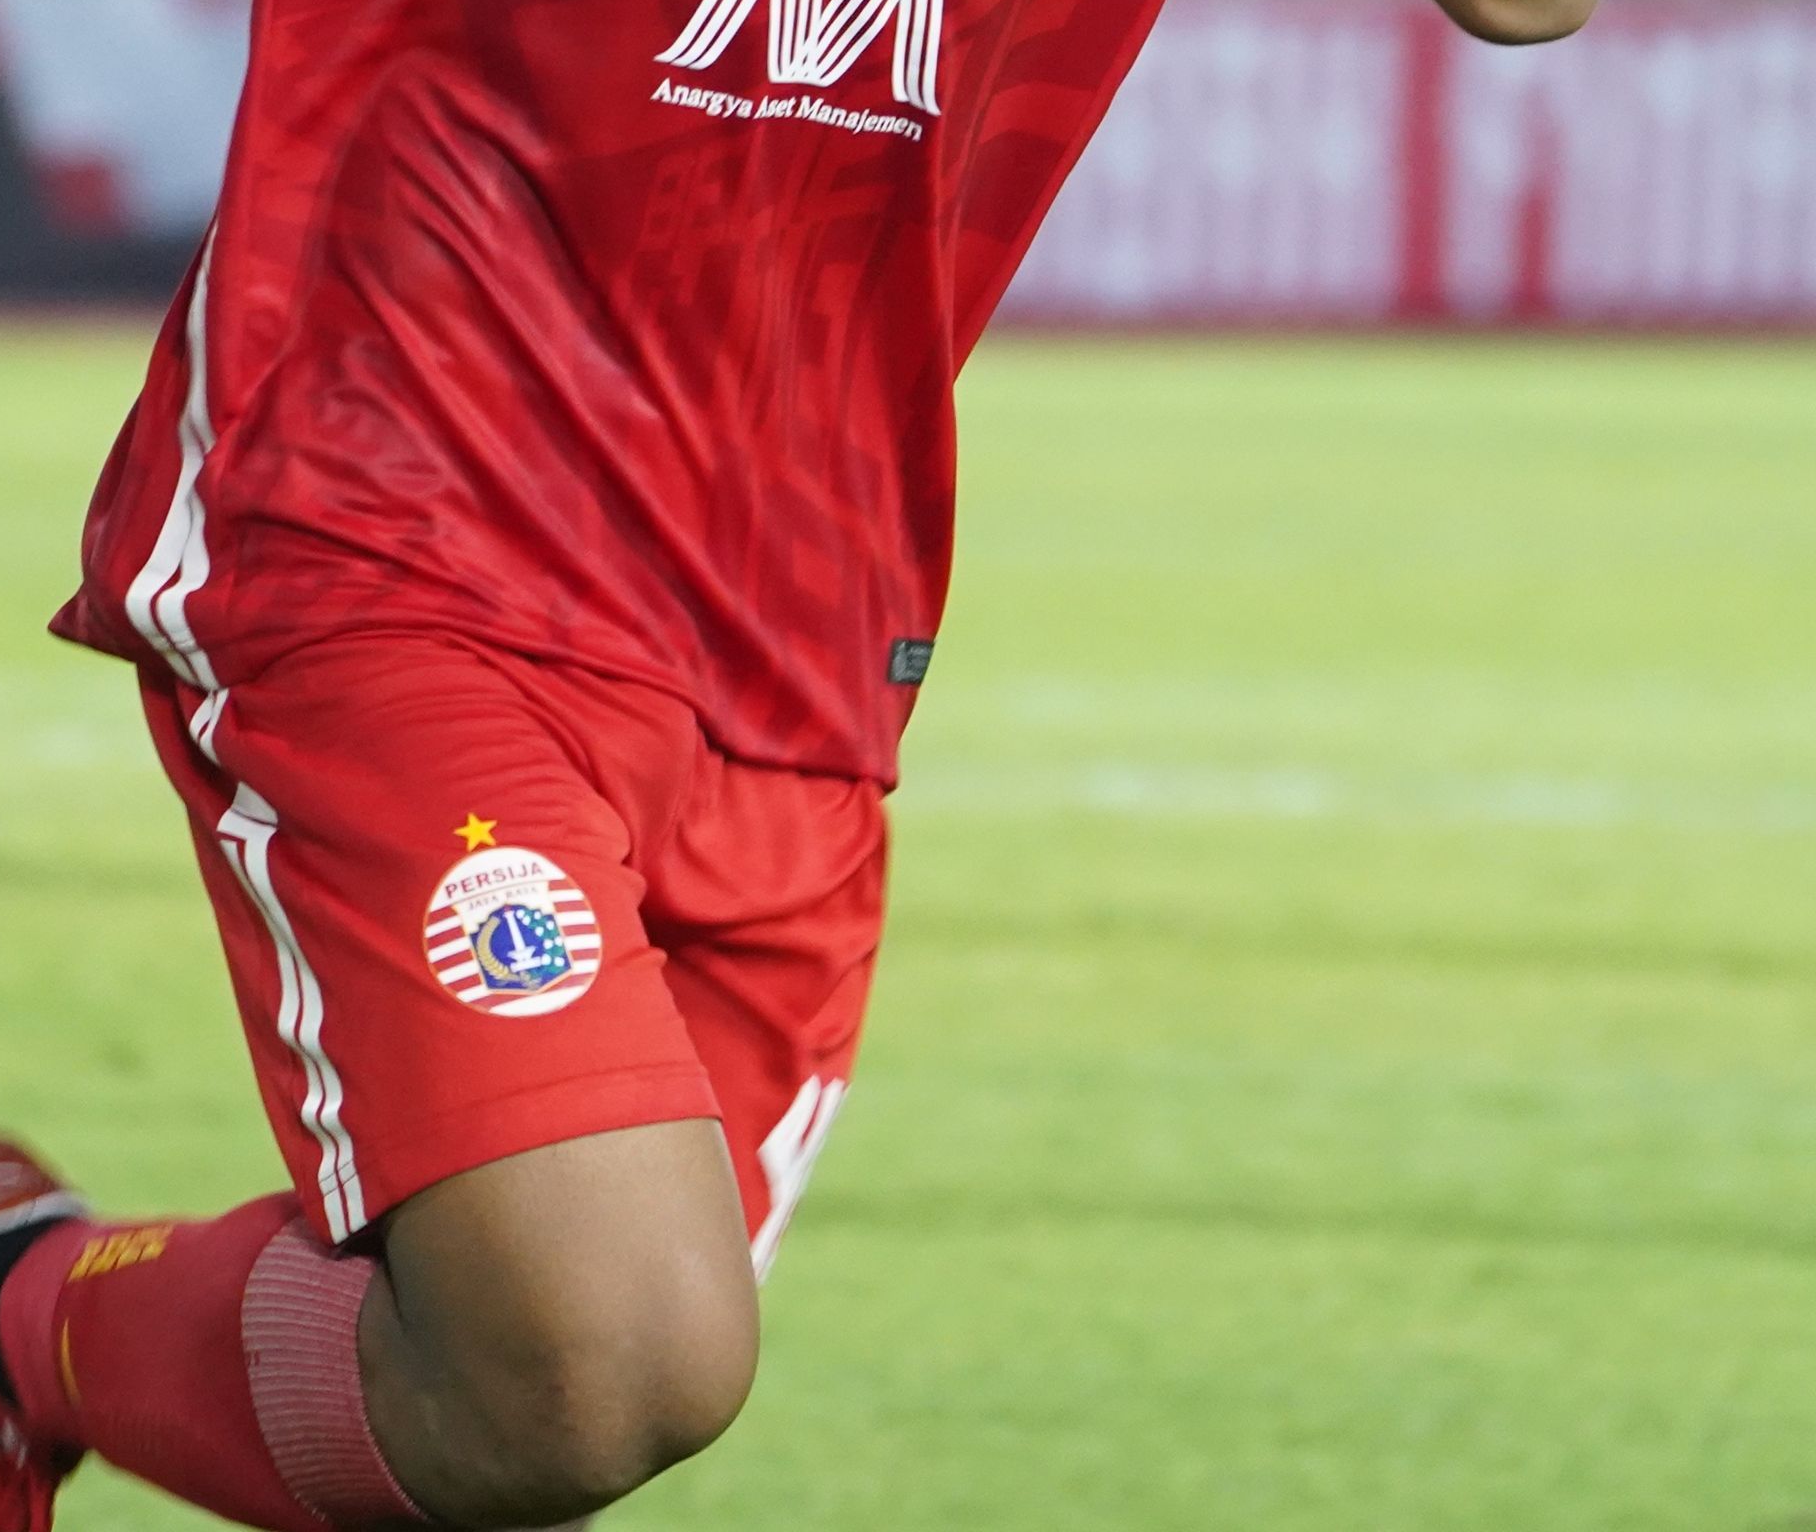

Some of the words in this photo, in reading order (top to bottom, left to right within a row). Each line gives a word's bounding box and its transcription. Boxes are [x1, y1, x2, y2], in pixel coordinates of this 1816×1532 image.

[650, 76, 754, 119] Anargya
[753, 94, 796, 120] Aset
[792, 94, 924, 143] Manajemen
[444, 861, 544, 900] PERSIJA
